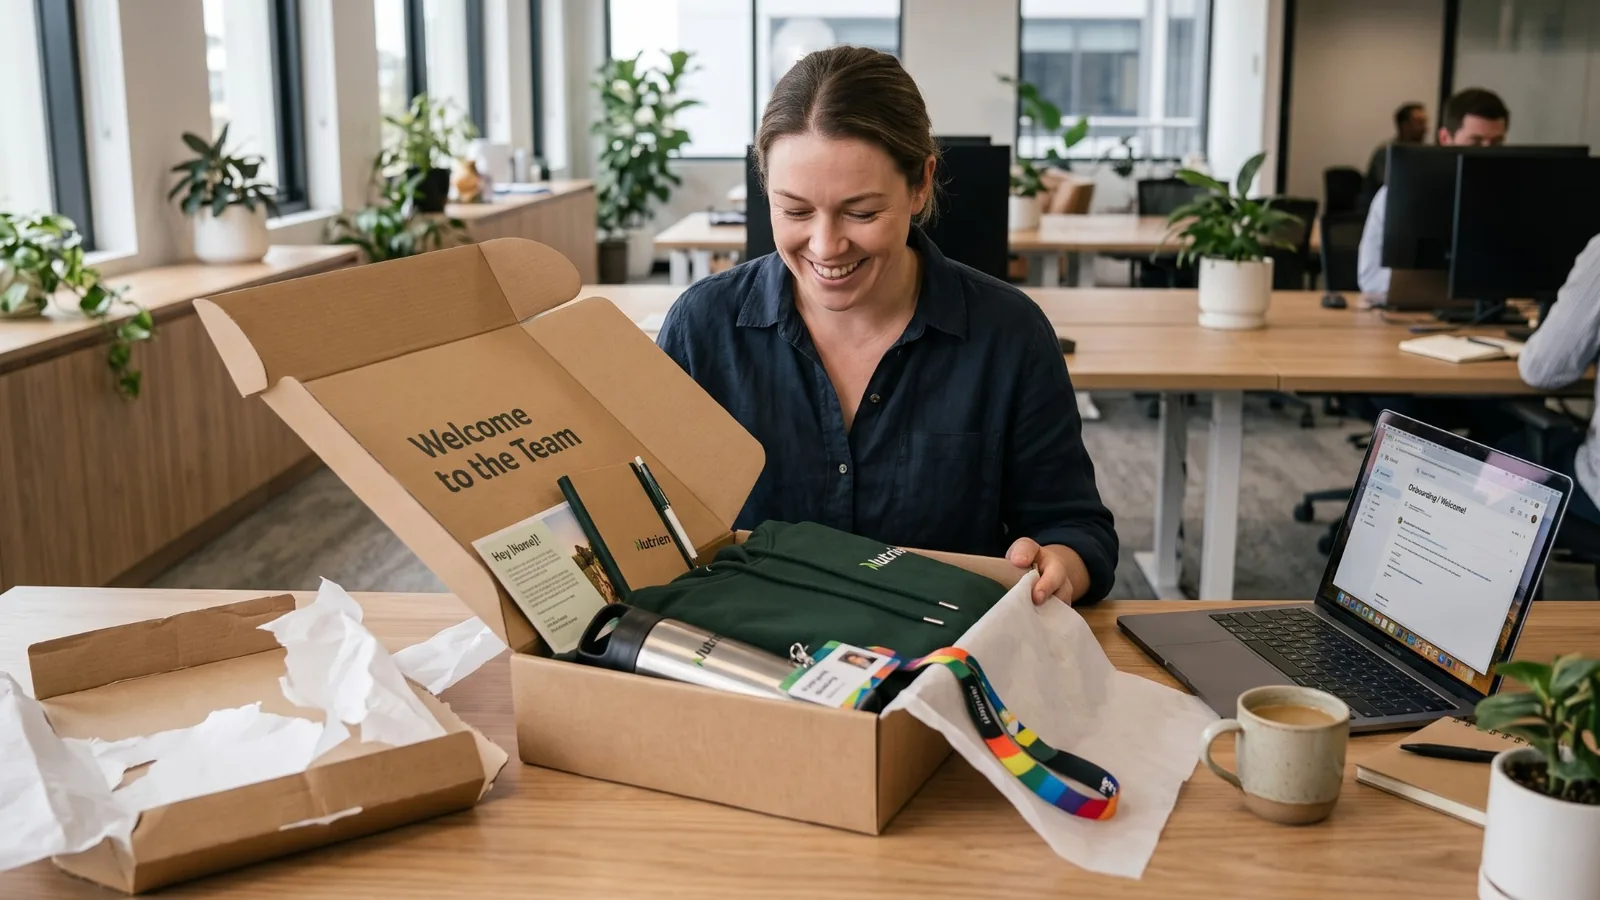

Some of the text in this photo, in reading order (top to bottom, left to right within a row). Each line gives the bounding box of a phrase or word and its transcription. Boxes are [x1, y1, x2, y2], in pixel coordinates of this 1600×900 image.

[407, 408, 532, 458] Welcome
[434, 428, 582, 492] to the Team
[491, 550, 512, 562] Hey
[634, 534, 671, 551] Nutrien
